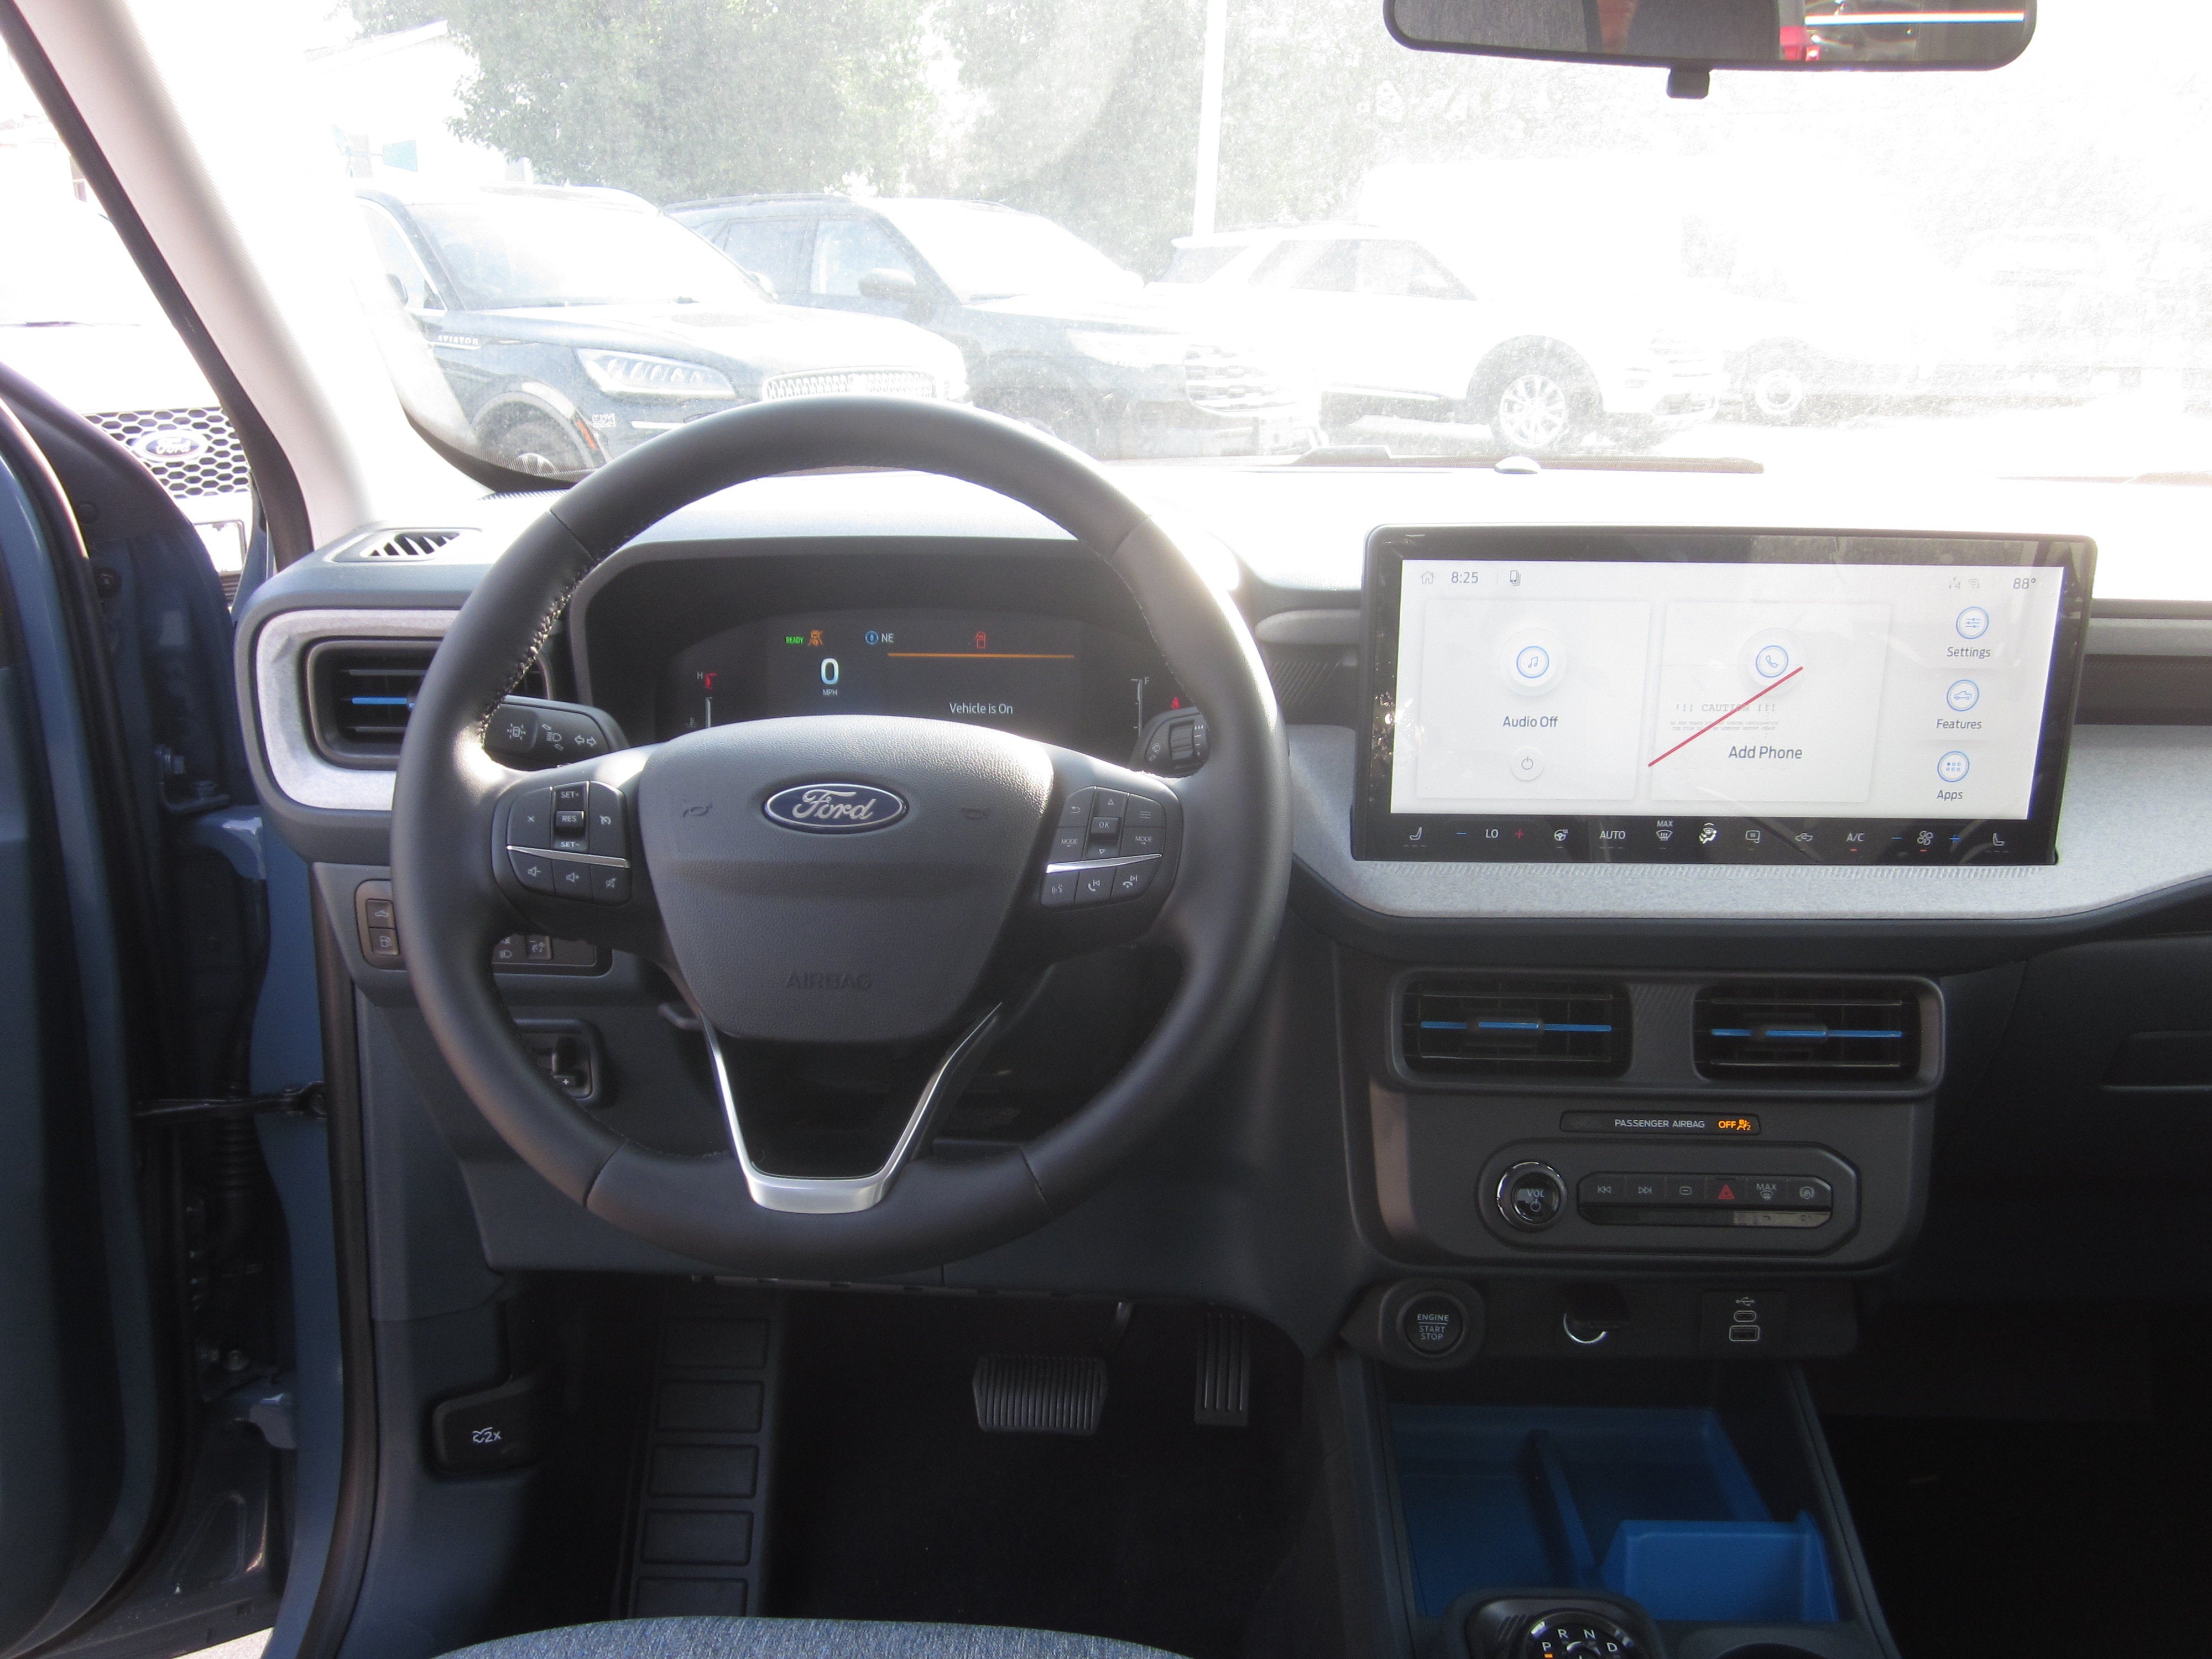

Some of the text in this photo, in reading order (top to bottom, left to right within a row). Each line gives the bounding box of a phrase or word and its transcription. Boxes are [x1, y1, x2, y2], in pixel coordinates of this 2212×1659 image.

[437, 335, 478, 345] AVIATOR
[1451, 572, 1479, 584] 8:25
[2013, 577, 2036, 589] 88°
[785, 636, 804, 645] READY
[881, 633, 894, 643] NE
[1946, 646, 1991, 659] Settings
[697, 671, 703, 680] H
[820, 658, 839, 685] 0
[949, 702, 1013, 714] Vehicle is On
[1503, 715, 1559, 728] Audio Off
[1936, 718, 1982, 730] Features
[1728, 745, 1803, 759] Add Phone
[1936, 789, 1963, 801] Apps
[792, 789, 877, 820] Ford
[1485, 828, 1499, 839] LO
[1599, 830, 1626, 840] AUTO
[1846, 832, 1864, 843] A/C
[1614, 1119, 1670, 1128] PASSENGER
[1672, 1119, 1705, 1129] AIRBAG
[1718, 1120, 1736, 1129] OFF
[1527, 1190, 1545, 1198] VOL
[1557, 1629, 1569, 1639] R
[1583, 1629, 1596, 1640] N
[1542, 1641, 1552, 1652] P
[1606, 1642, 1618, 1652] D
